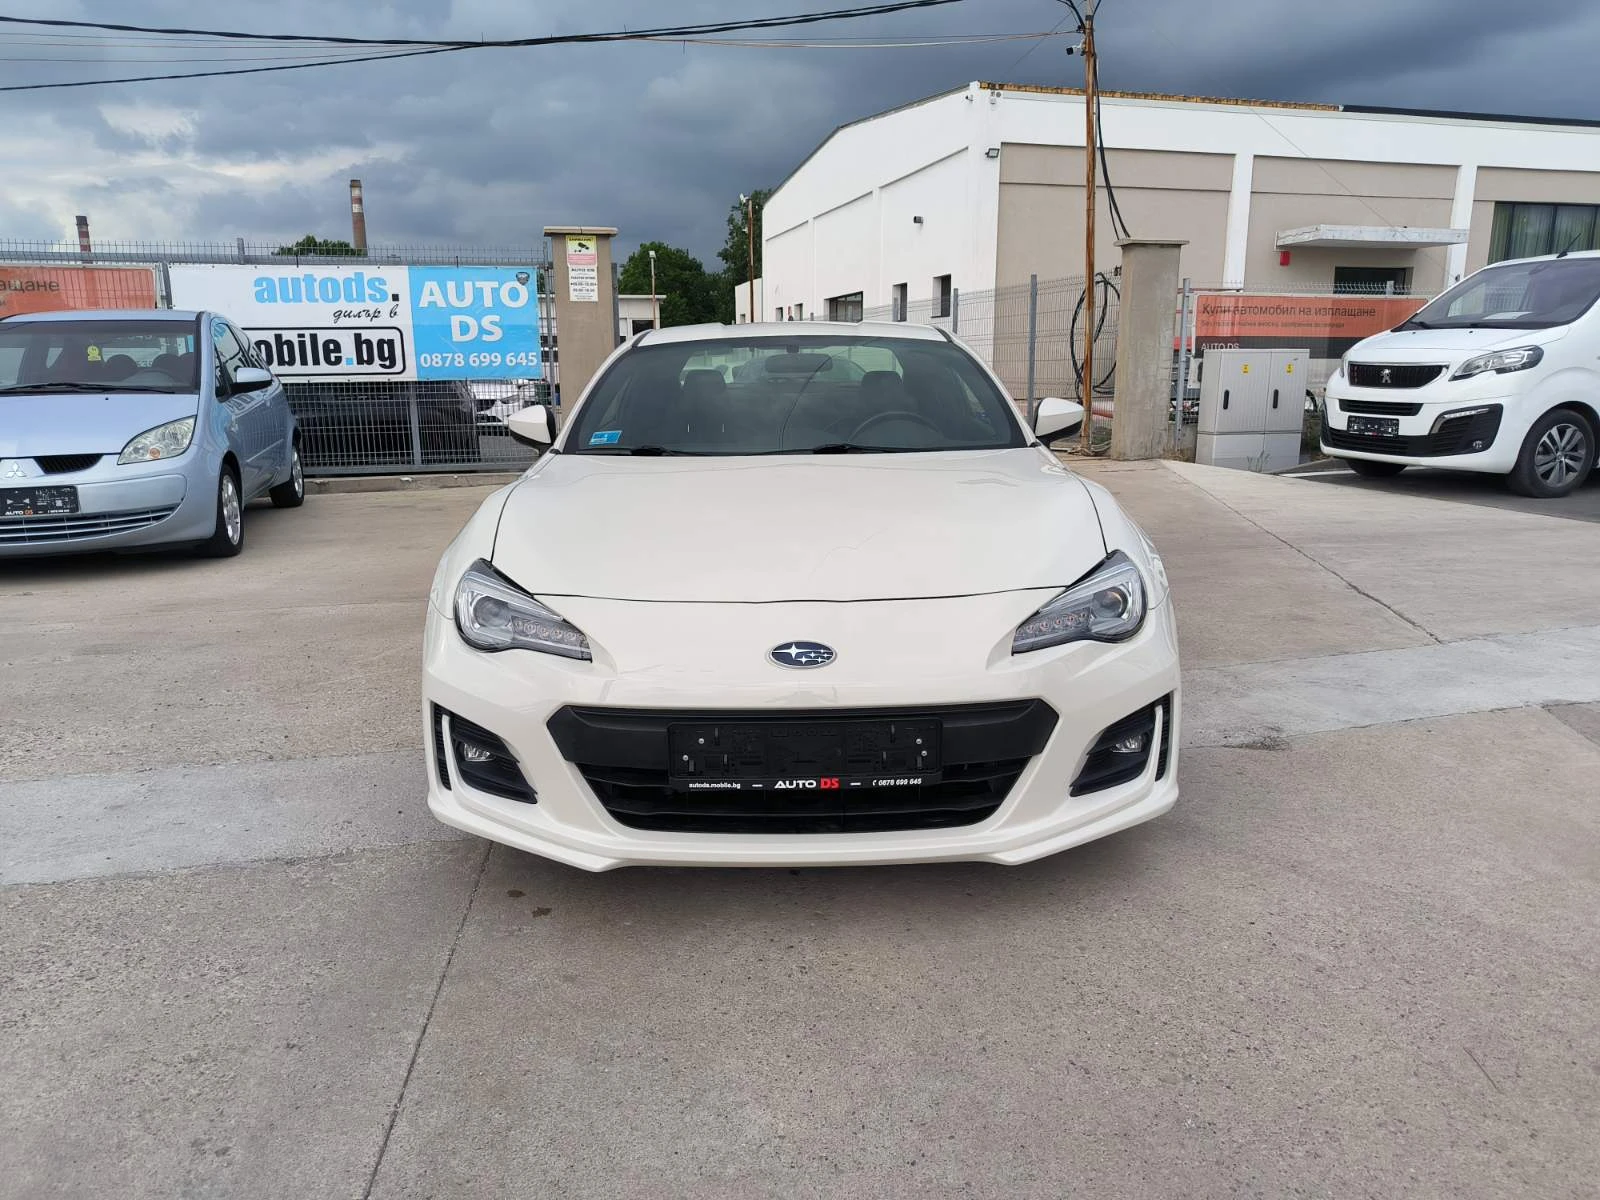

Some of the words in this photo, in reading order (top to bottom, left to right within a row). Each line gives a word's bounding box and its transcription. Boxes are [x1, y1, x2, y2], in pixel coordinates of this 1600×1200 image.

[254, 271, 399, 303] autods.
[419, 281, 529, 308] AUTO
[333, 309, 381, 323] дилър
[389, 304, 399, 318] в
[1202, 304, 1230, 317] Купи
[1233, 304, 1296, 316] автомобил
[1298, 307, 1312, 316] на
[1314, 307, 1376, 318] изплащане
[450, 315, 503, 341] DS
[253, 333, 397, 369] obile.bg
[420, 353, 465, 367] 0878
[469, 353, 502, 367] 699
[506, 352, 538, 366] 645
[774, 780, 817, 789] AUTO
[820, 778, 840, 789] DS
